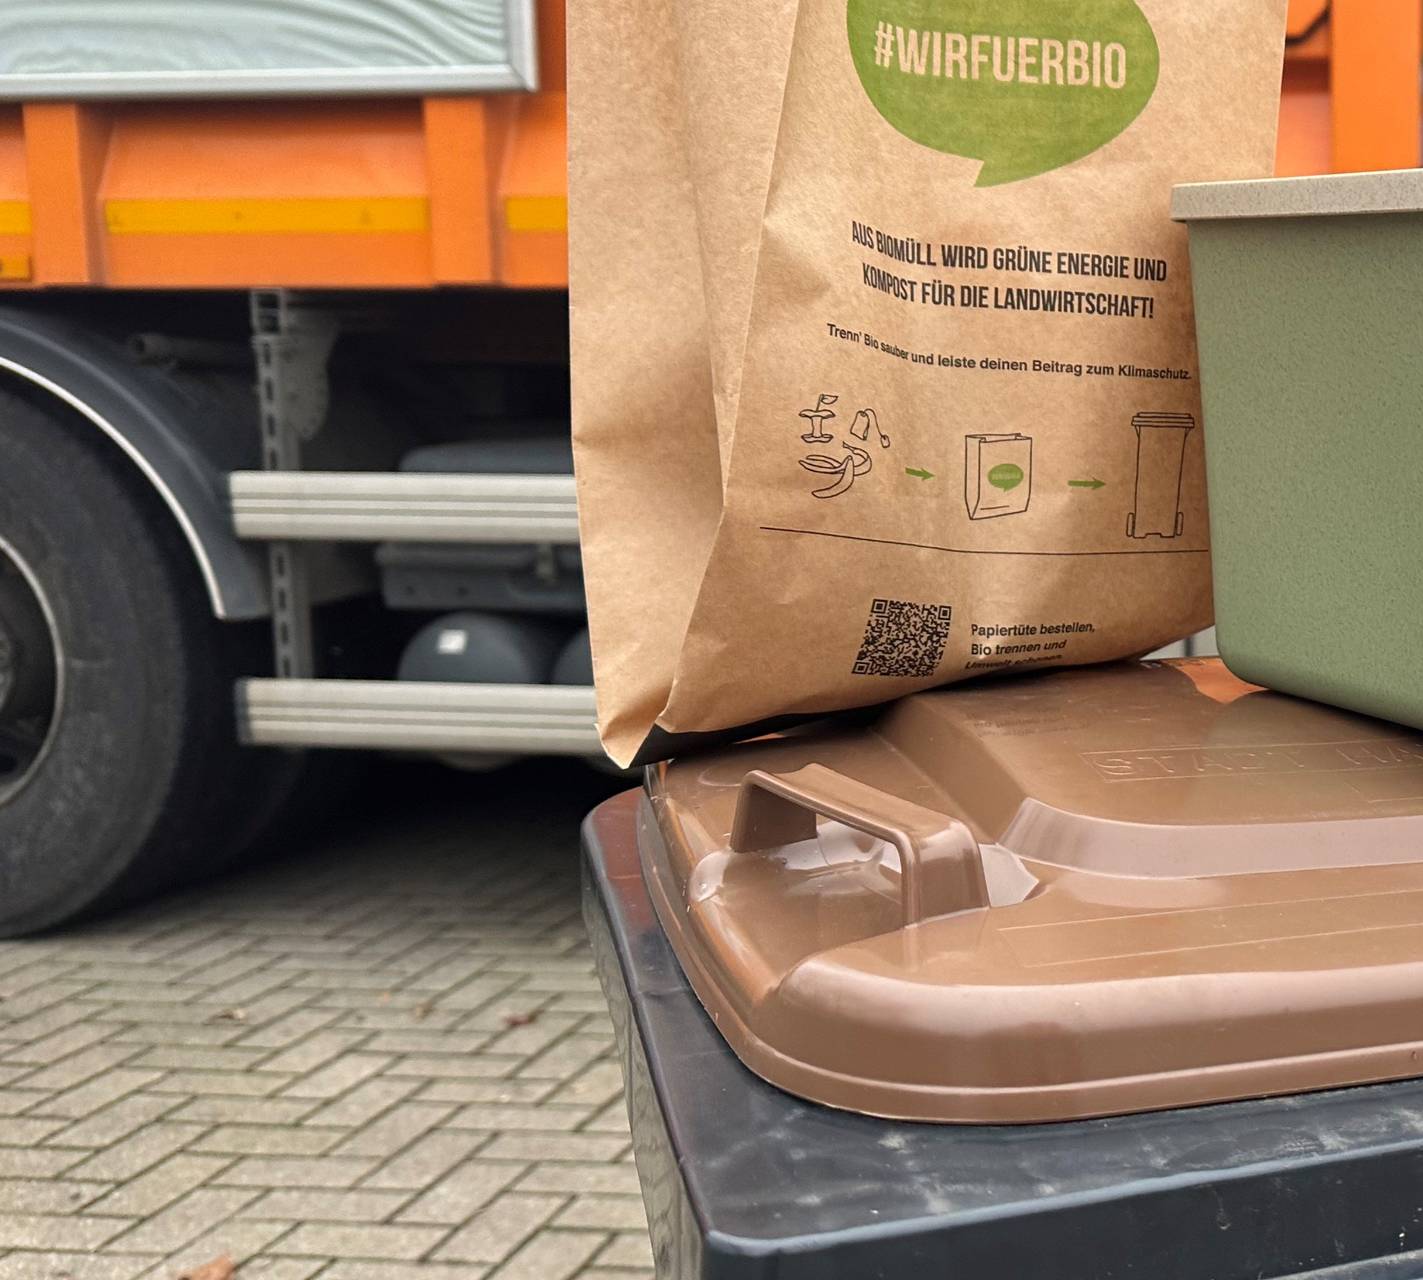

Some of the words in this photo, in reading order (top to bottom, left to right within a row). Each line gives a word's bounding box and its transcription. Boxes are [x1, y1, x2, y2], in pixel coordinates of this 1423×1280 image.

[873, 20, 1127, 89] #WIRFUERBIO
[852, 221, 874, 249] AUS
[876, 230, 937, 266] BIOMÜLL
[941, 244, 988, 269] WIRD
[993, 246, 1052, 274] GRÜNE
[1057, 252, 1130, 279] ENERGIE
[1134, 257, 1167, 281] UND
[862, 262, 917, 302] KOMPOST
[922, 279, 955, 305] FÜR
[960, 285, 989, 308] DIE
[994, 287, 1154, 319] LANDWIRTSCHAFT!
[827, 323, 862, 343] Trenn'
[864, 333, 879, 350] Bio
[880, 341, 909, 360] sauber
[911, 351, 934, 365] und
[938, 355, 976, 369] leiste
[979, 357, 1028, 372] deinen
[1032, 359, 1083, 377] Beitrag
[1086, 364, 1114, 377] zum
[1118, 365, 1192, 381] Klimaschutz.
[971, 623, 1037, 638] Papiertüte
[1039, 622, 1096, 635] bestellen,
[971, 643, 992, 656] Bio
[995, 643, 1041, 655] trennen
[1043, 640, 1067, 650] und
